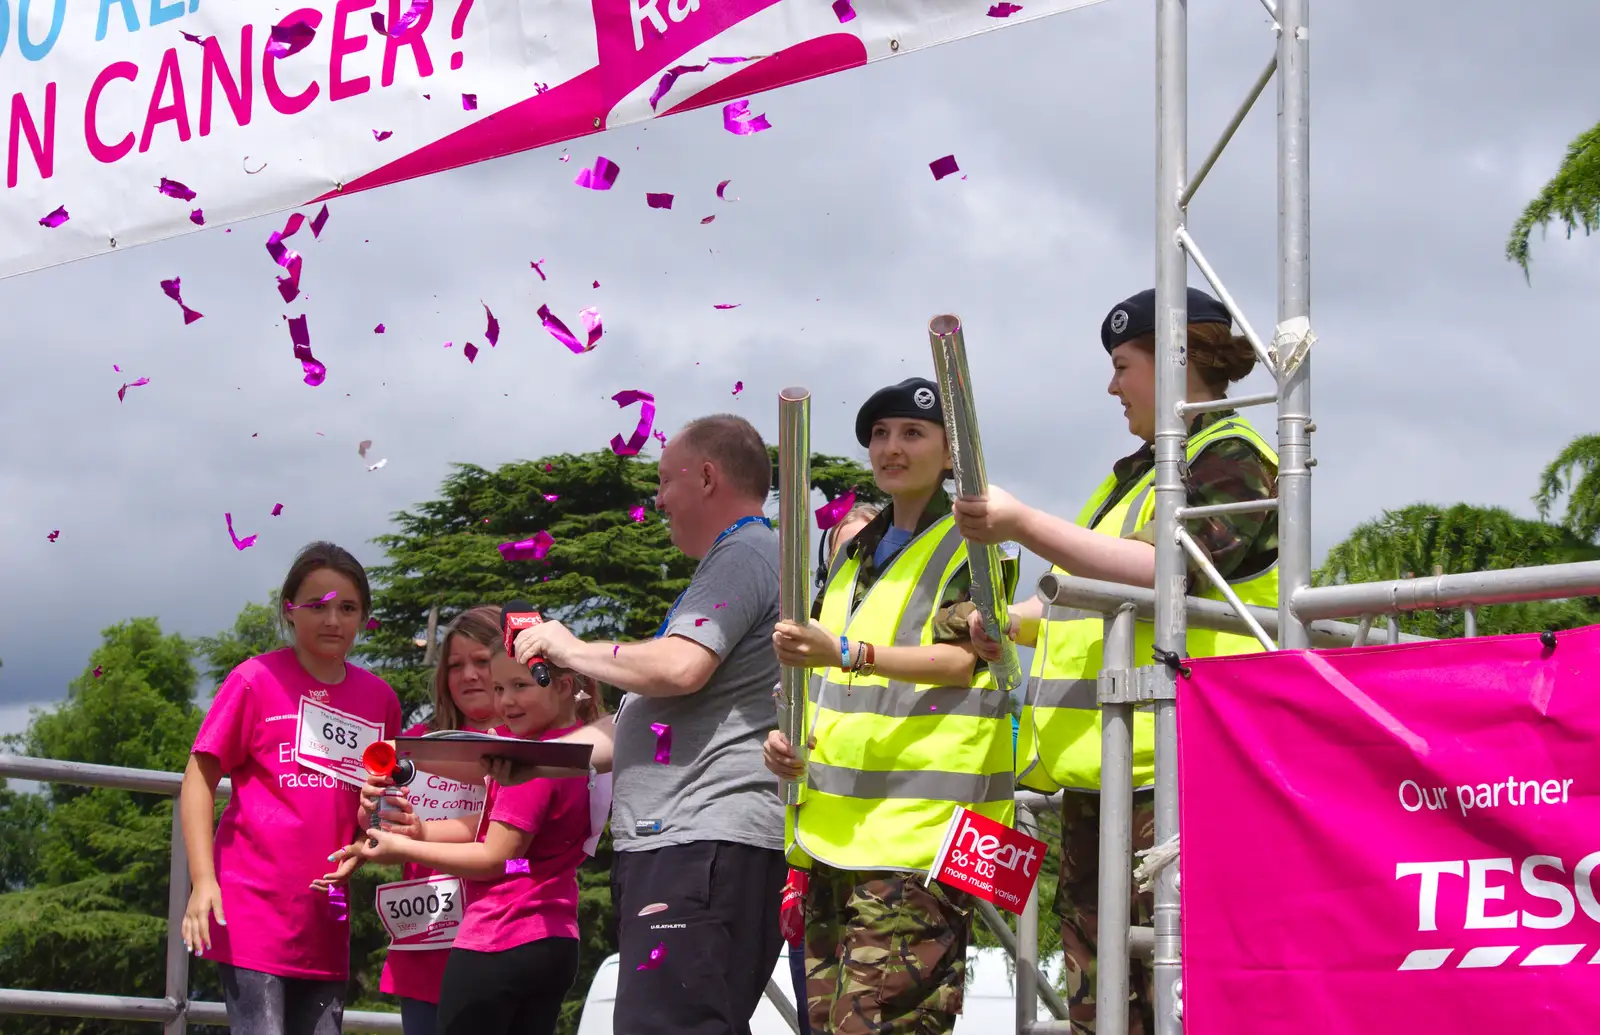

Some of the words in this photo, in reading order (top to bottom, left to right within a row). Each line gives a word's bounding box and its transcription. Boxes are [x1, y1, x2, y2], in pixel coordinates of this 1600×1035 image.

[84, 0, 475, 163] CANCER?
[322, 722, 358, 749] 683
[1399, 780, 1447, 812] Our
[1456, 776, 1573, 817] partner
[951, 849, 996, 879] 96-103
[956, 818, 1037, 878] heart
[386, 893, 454, 919] 30003
[945, 866, 967, 881] more
[968, 876, 993, 892] music
[995, 887, 1020, 906] variety
